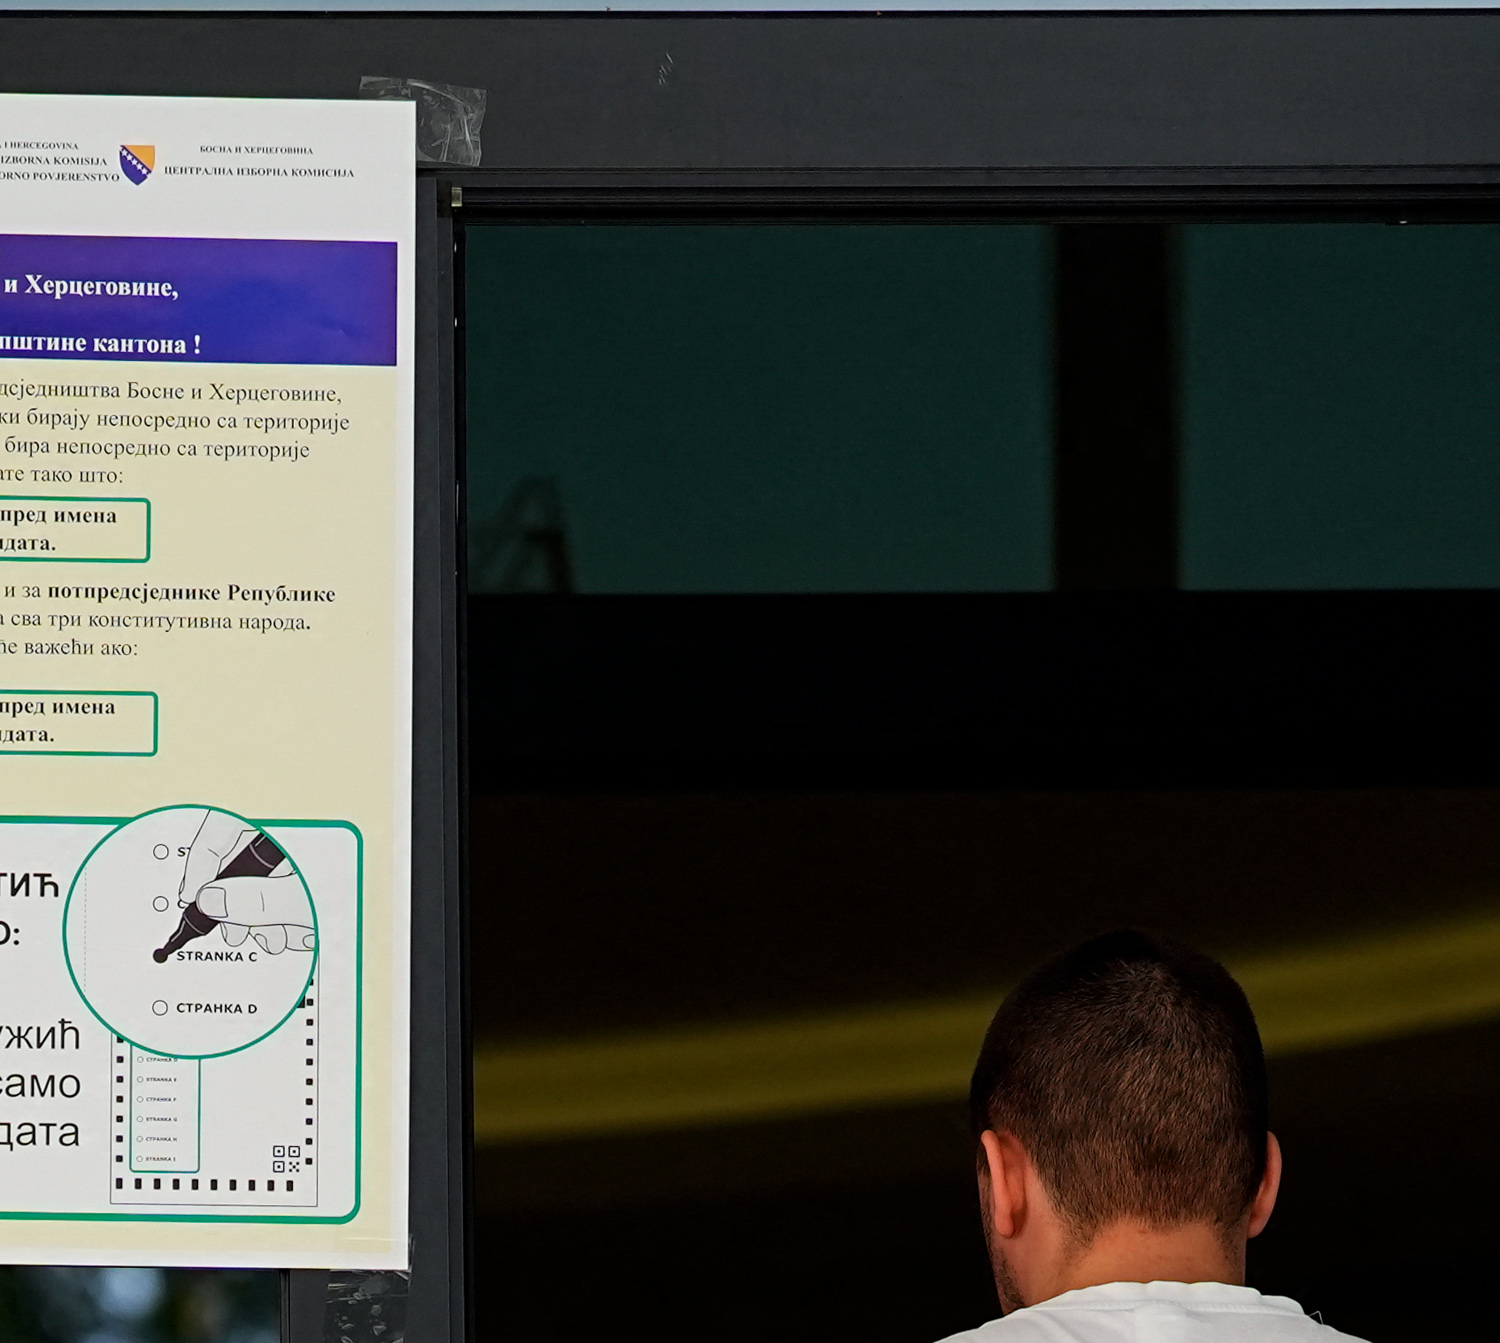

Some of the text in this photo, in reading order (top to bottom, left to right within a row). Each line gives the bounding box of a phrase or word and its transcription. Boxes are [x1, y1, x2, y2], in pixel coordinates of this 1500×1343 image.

[200, 145, 232, 153] БОСНА
[244, 146, 313, 155] ХЕРЦЕГОВИНА
[55, 511, 116, 523] имена
